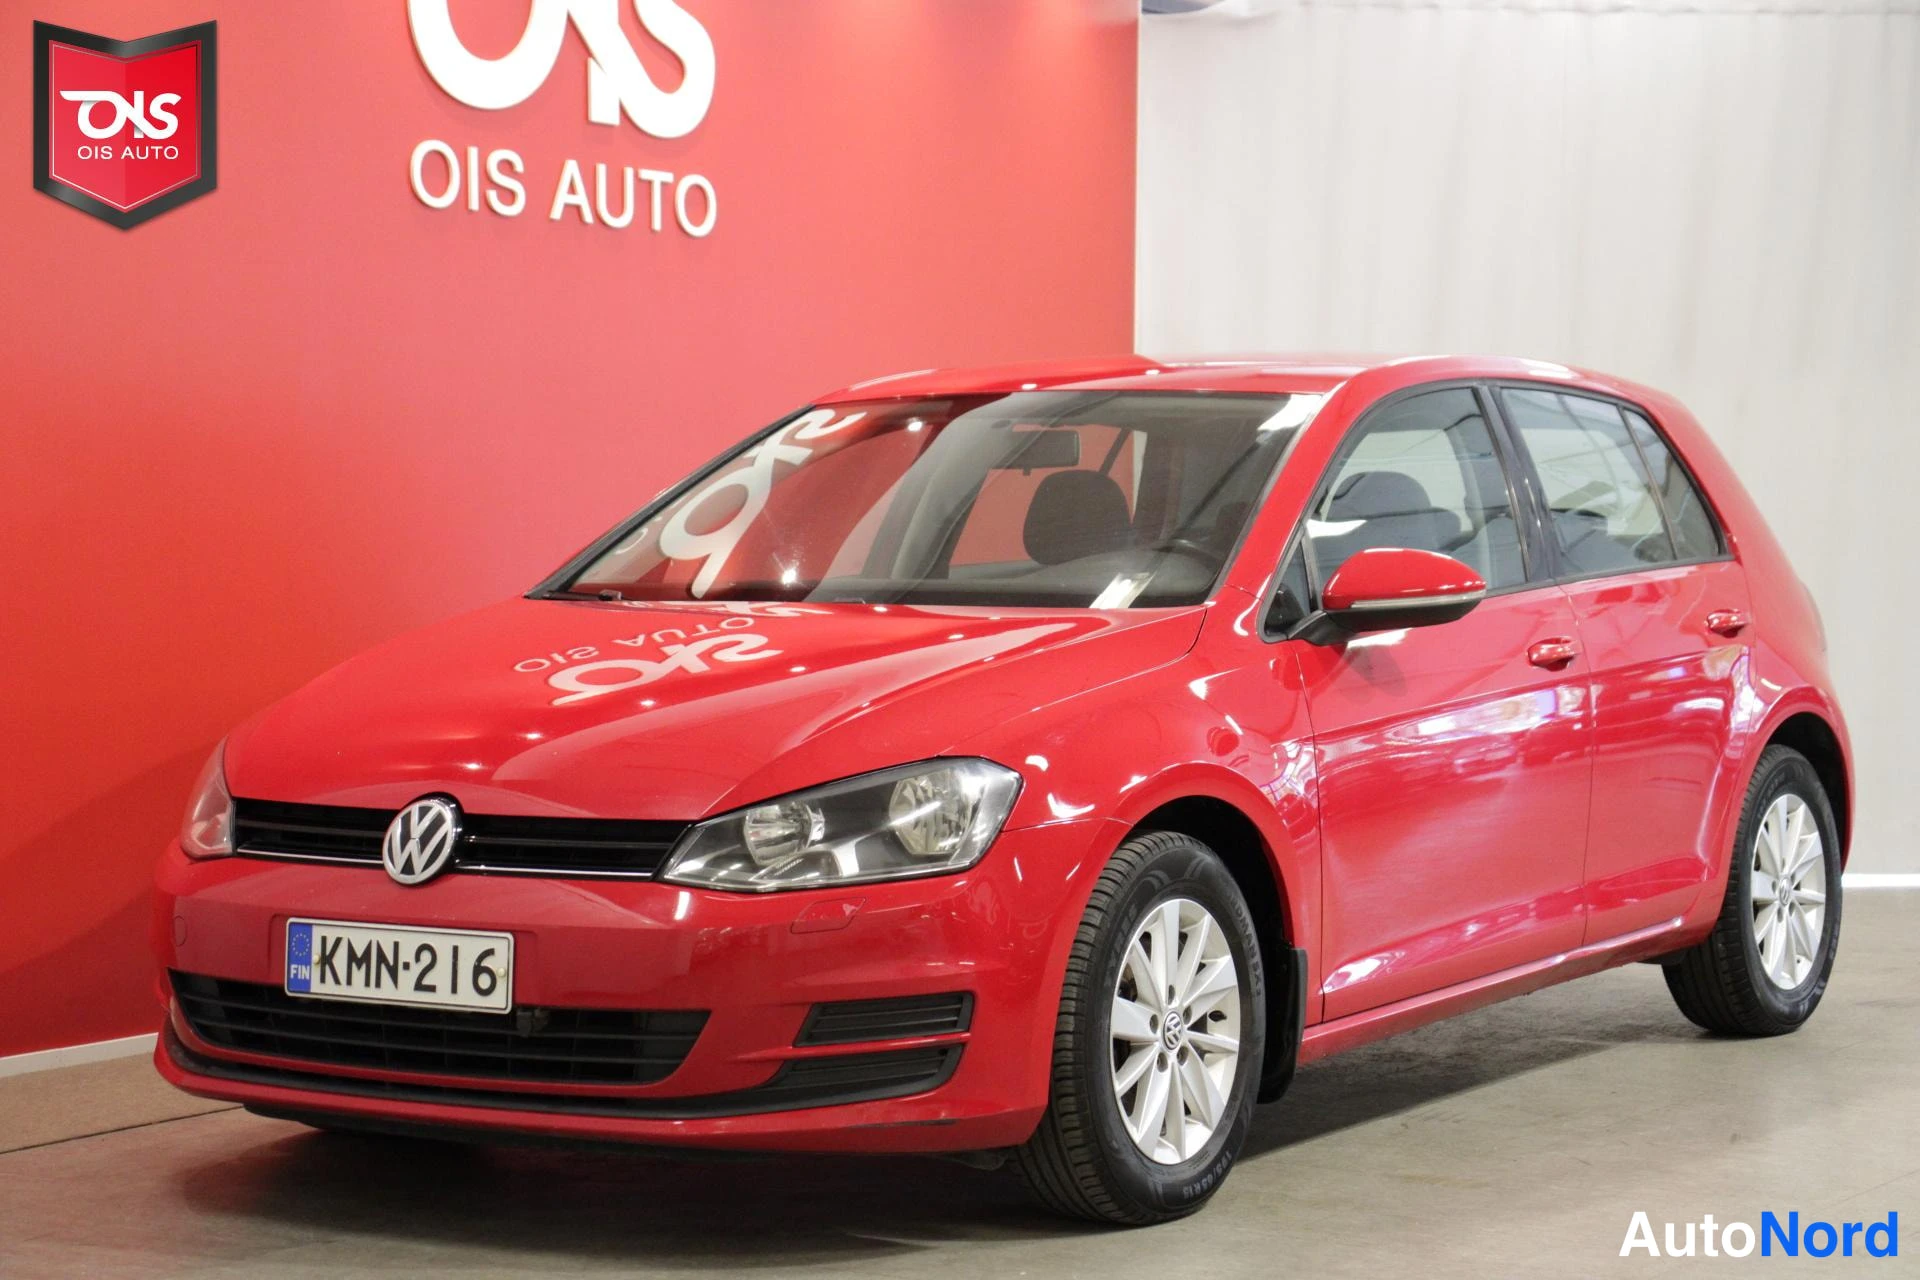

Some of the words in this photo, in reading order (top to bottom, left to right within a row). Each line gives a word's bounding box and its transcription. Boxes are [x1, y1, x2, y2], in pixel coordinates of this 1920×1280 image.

[409, 139, 526, 217] OIS
[549, 159, 717, 238] AUTO
[290, 964, 310, 980] FIN
[319, 935, 497, 997] KMN-216
